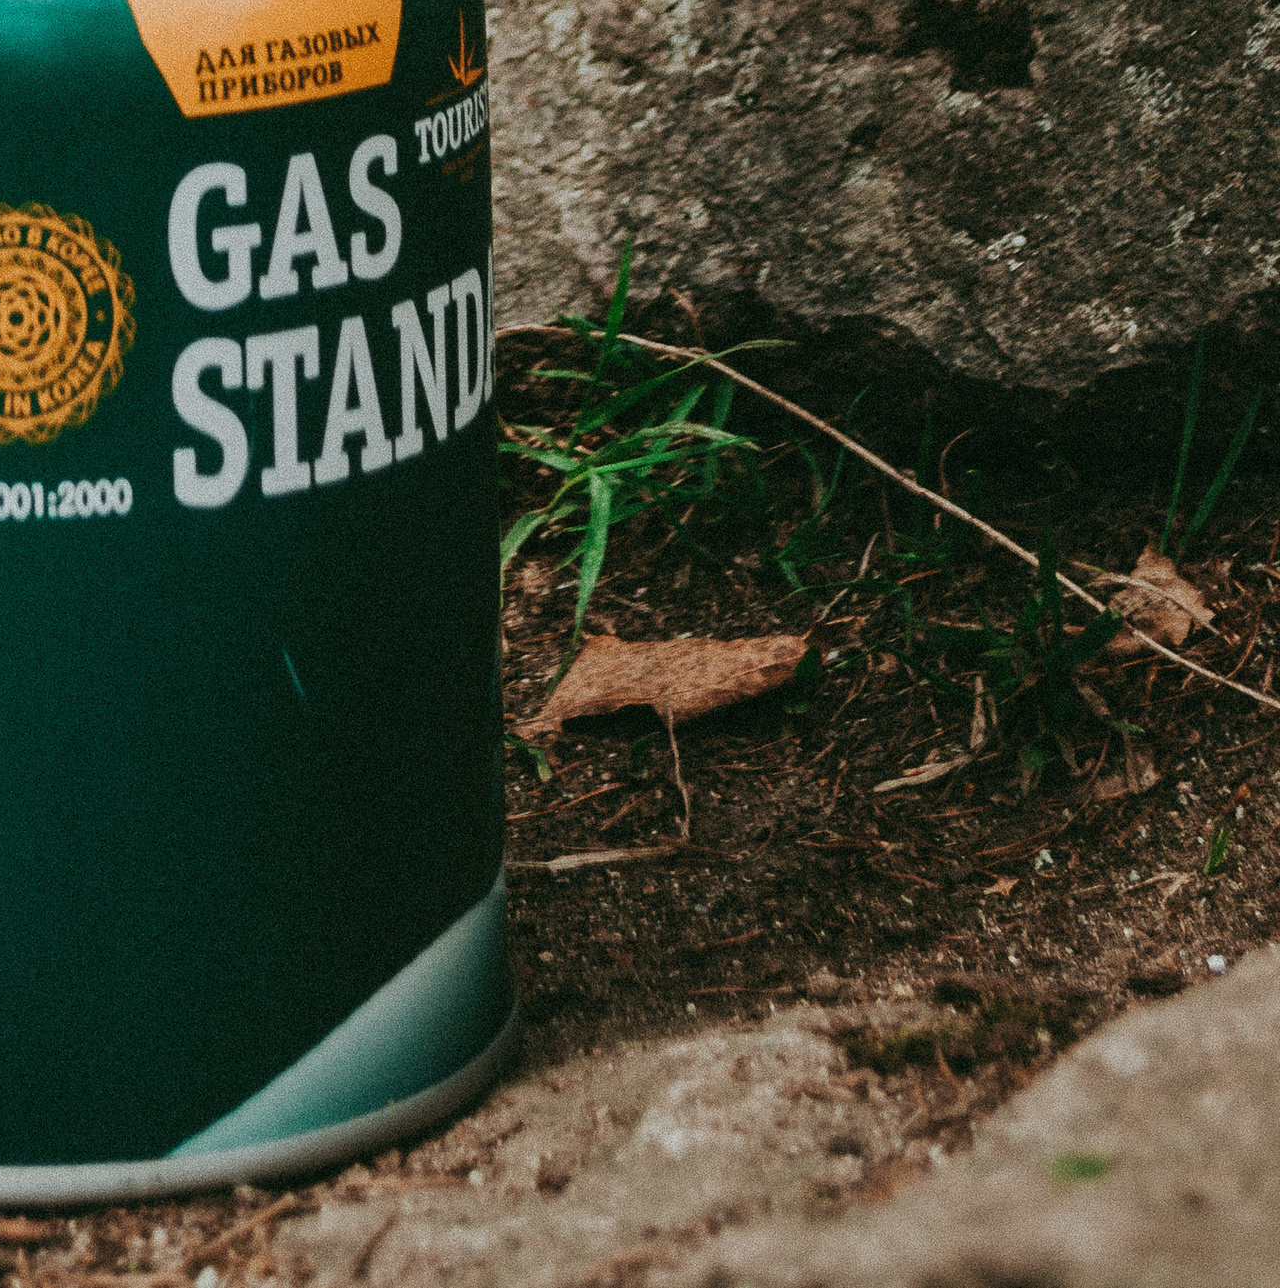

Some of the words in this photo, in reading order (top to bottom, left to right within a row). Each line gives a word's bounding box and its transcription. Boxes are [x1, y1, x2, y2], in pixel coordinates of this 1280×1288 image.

[195, 42, 257, 76] ДЛЯ
[264, 22, 381, 63] ГАЗОВЫХ
[198, 60, 344, 102] ПРИБОРОВ
[414, 80, 489, 165] TOURIS
[167, 134, 403, 312] GAS
